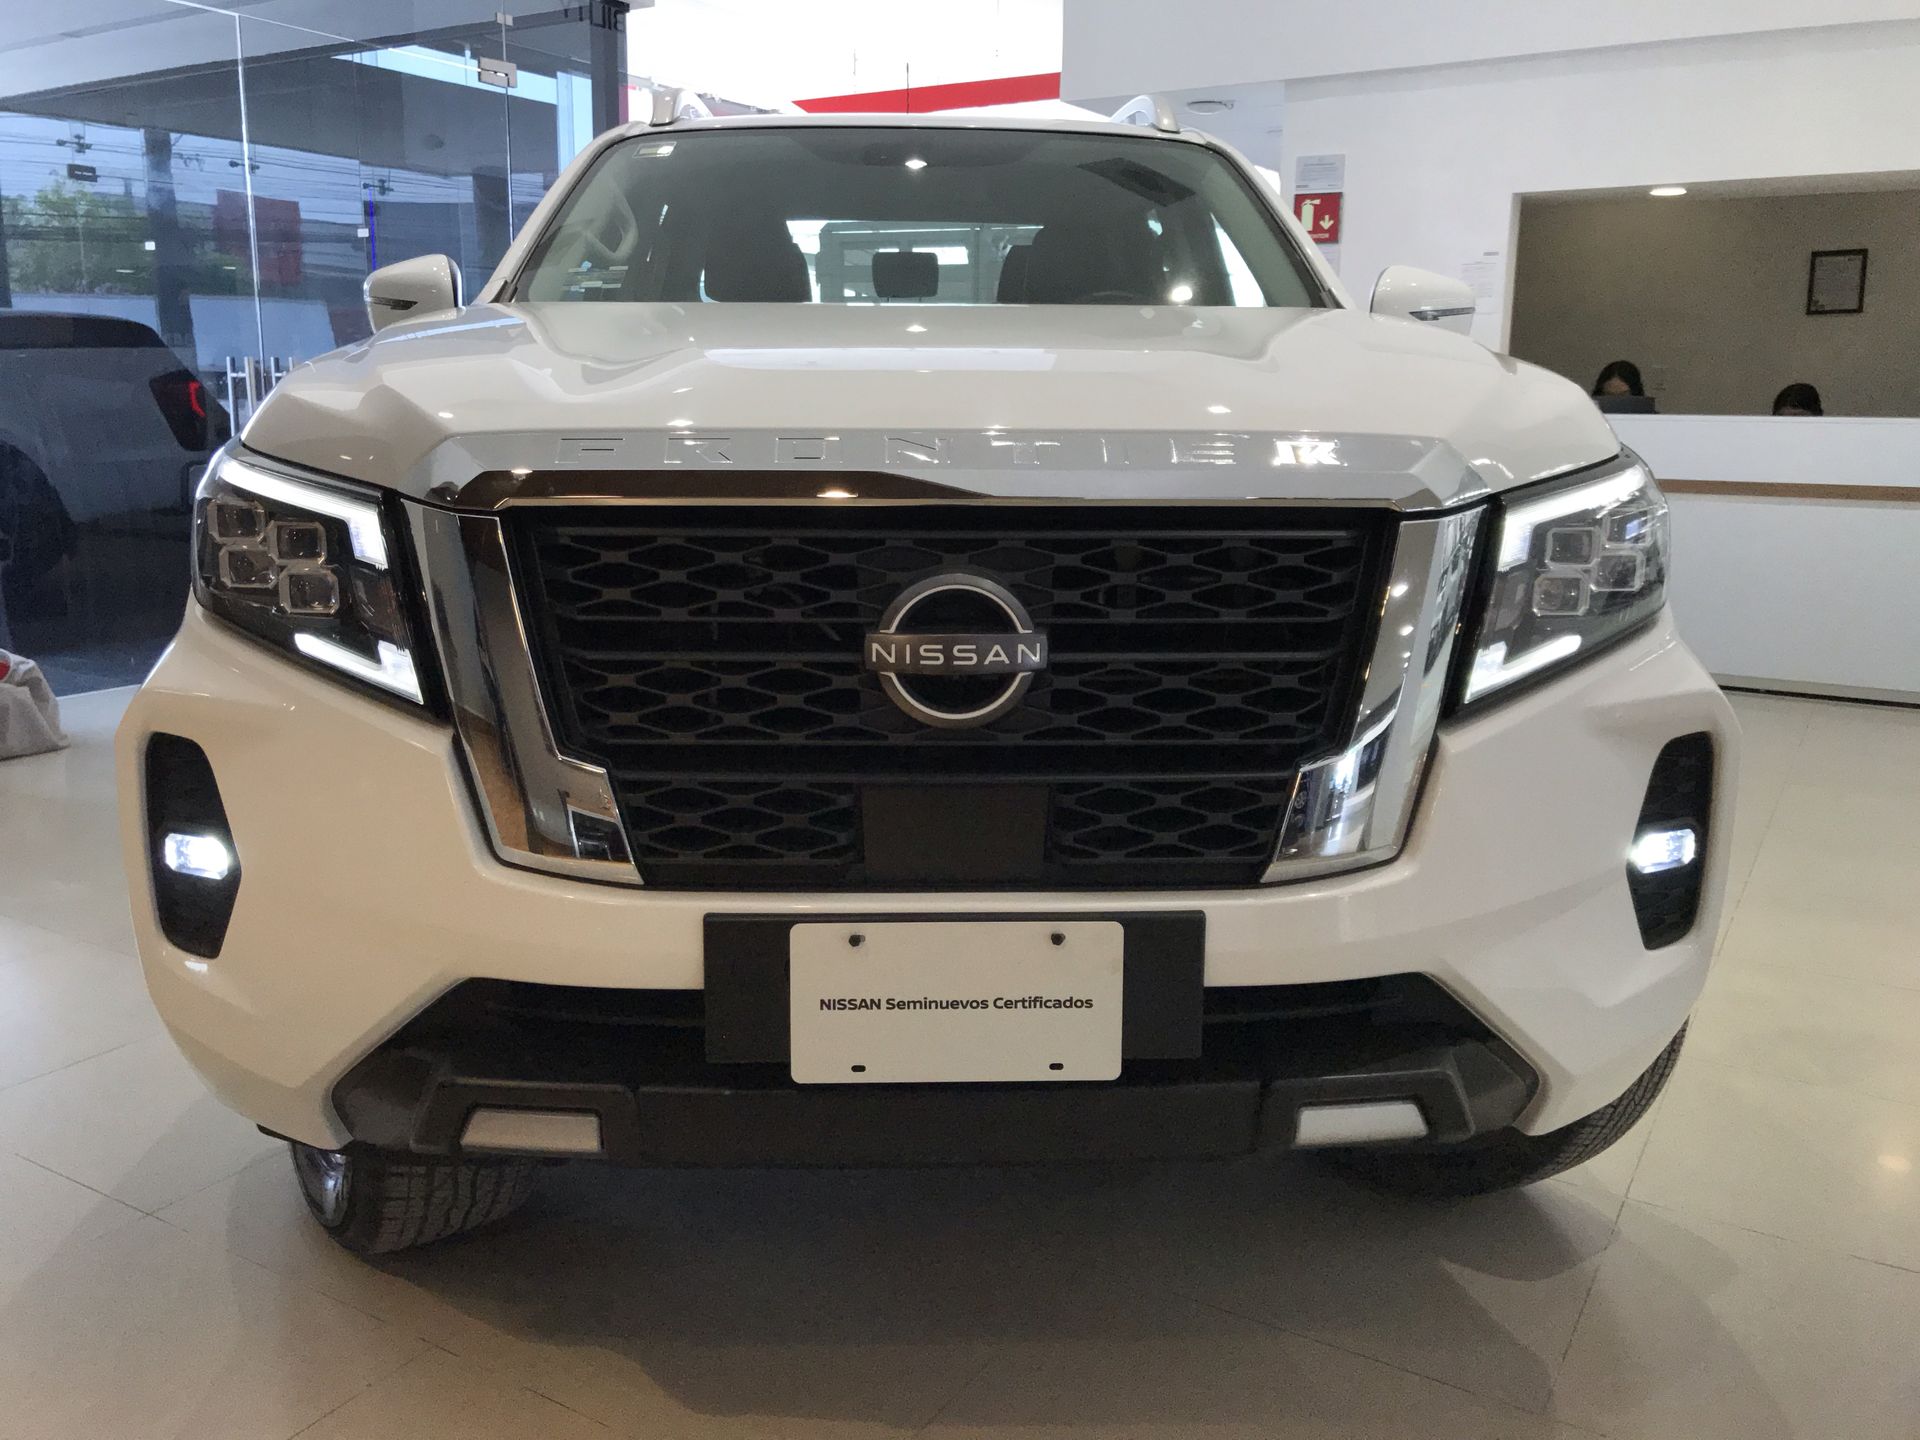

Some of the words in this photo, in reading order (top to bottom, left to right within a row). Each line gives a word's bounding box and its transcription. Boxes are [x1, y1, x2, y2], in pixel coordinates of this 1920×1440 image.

[554, 436, 1348, 466] FRONTIER
[871, 643, 1041, 665] NISSAN
[819, 998, 882, 1011] NISSAN
[885, 997, 989, 1010] Seminuevos
[993, 996, 1094, 1010] Certificados
